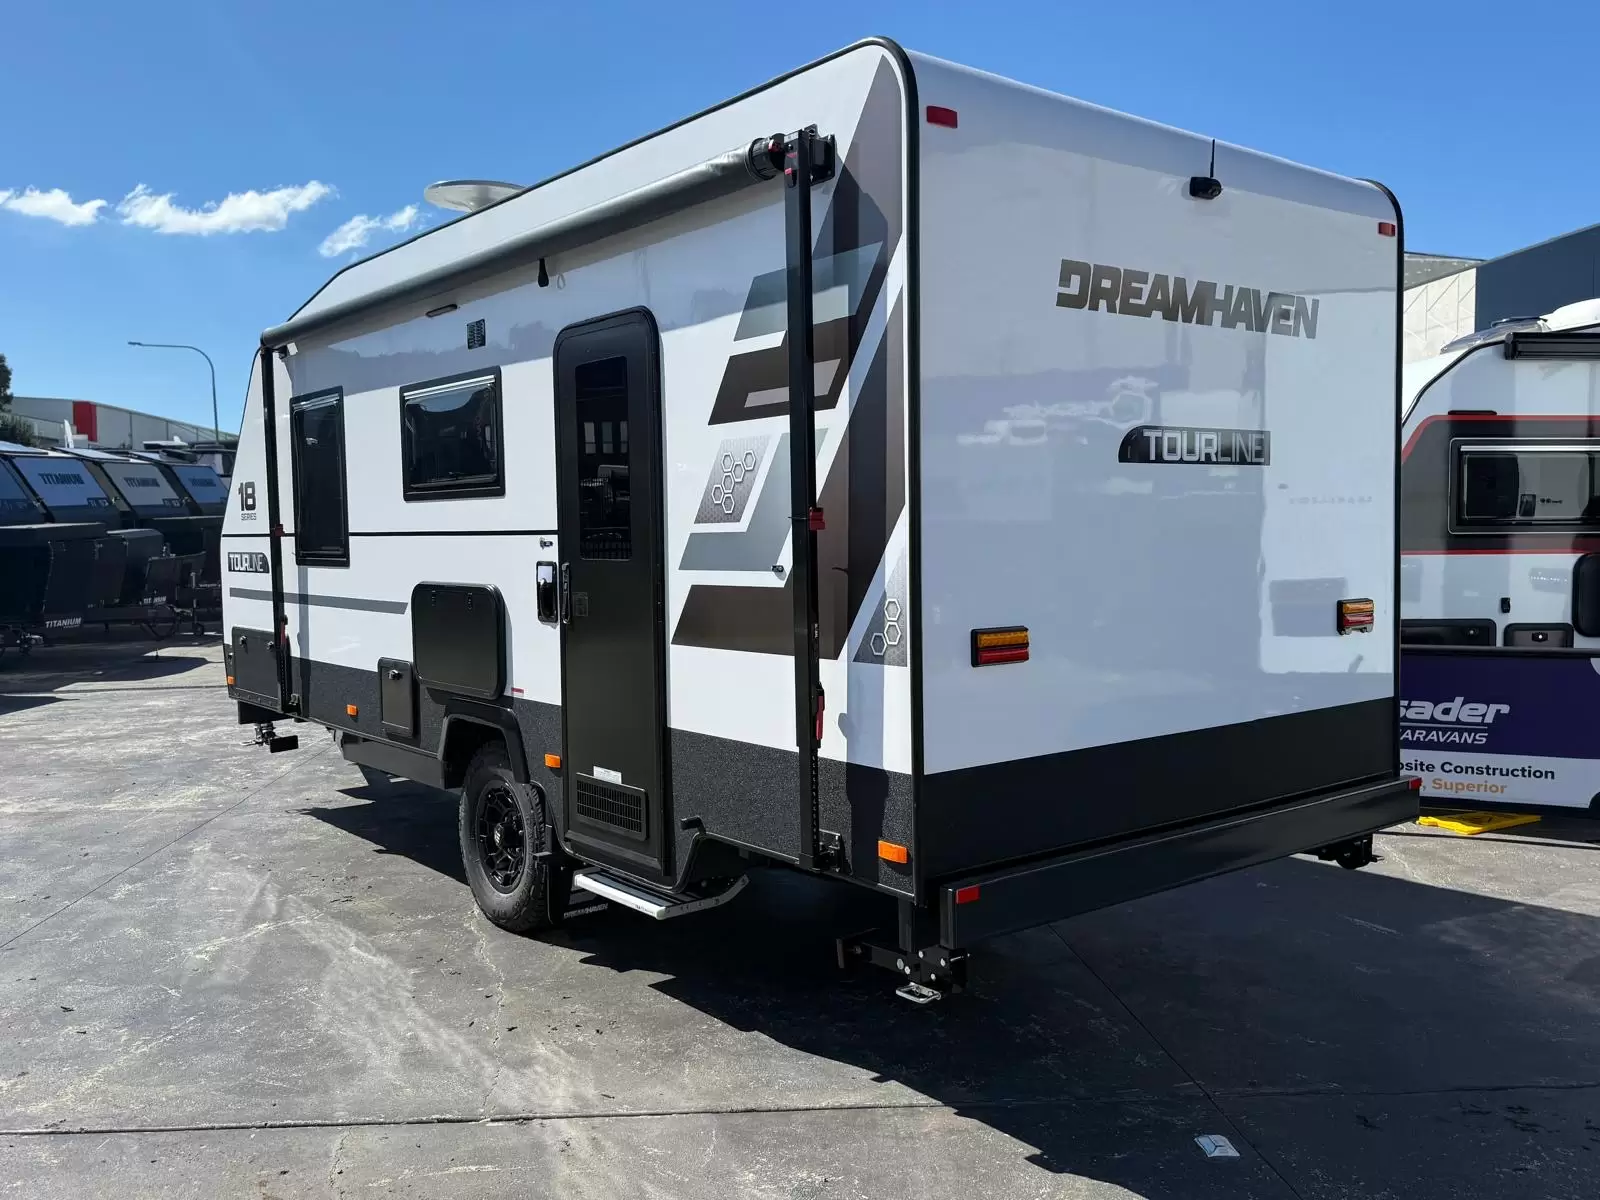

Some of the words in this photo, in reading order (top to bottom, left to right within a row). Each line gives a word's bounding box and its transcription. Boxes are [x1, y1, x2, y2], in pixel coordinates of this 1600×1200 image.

[1056, 259, 1319, 339] DREAMHAVEN
[1142, 428, 1264, 463] TOURLINE
[238, 482, 256, 511] 18
[241, 513, 257, 521] SERIES
[229, 553, 264, 572] TOURLINE
[45, 617, 82, 628] TITANIUM
[1440, 761, 1556, 780] Construction
[1431, 778, 1508, 794] Superior
